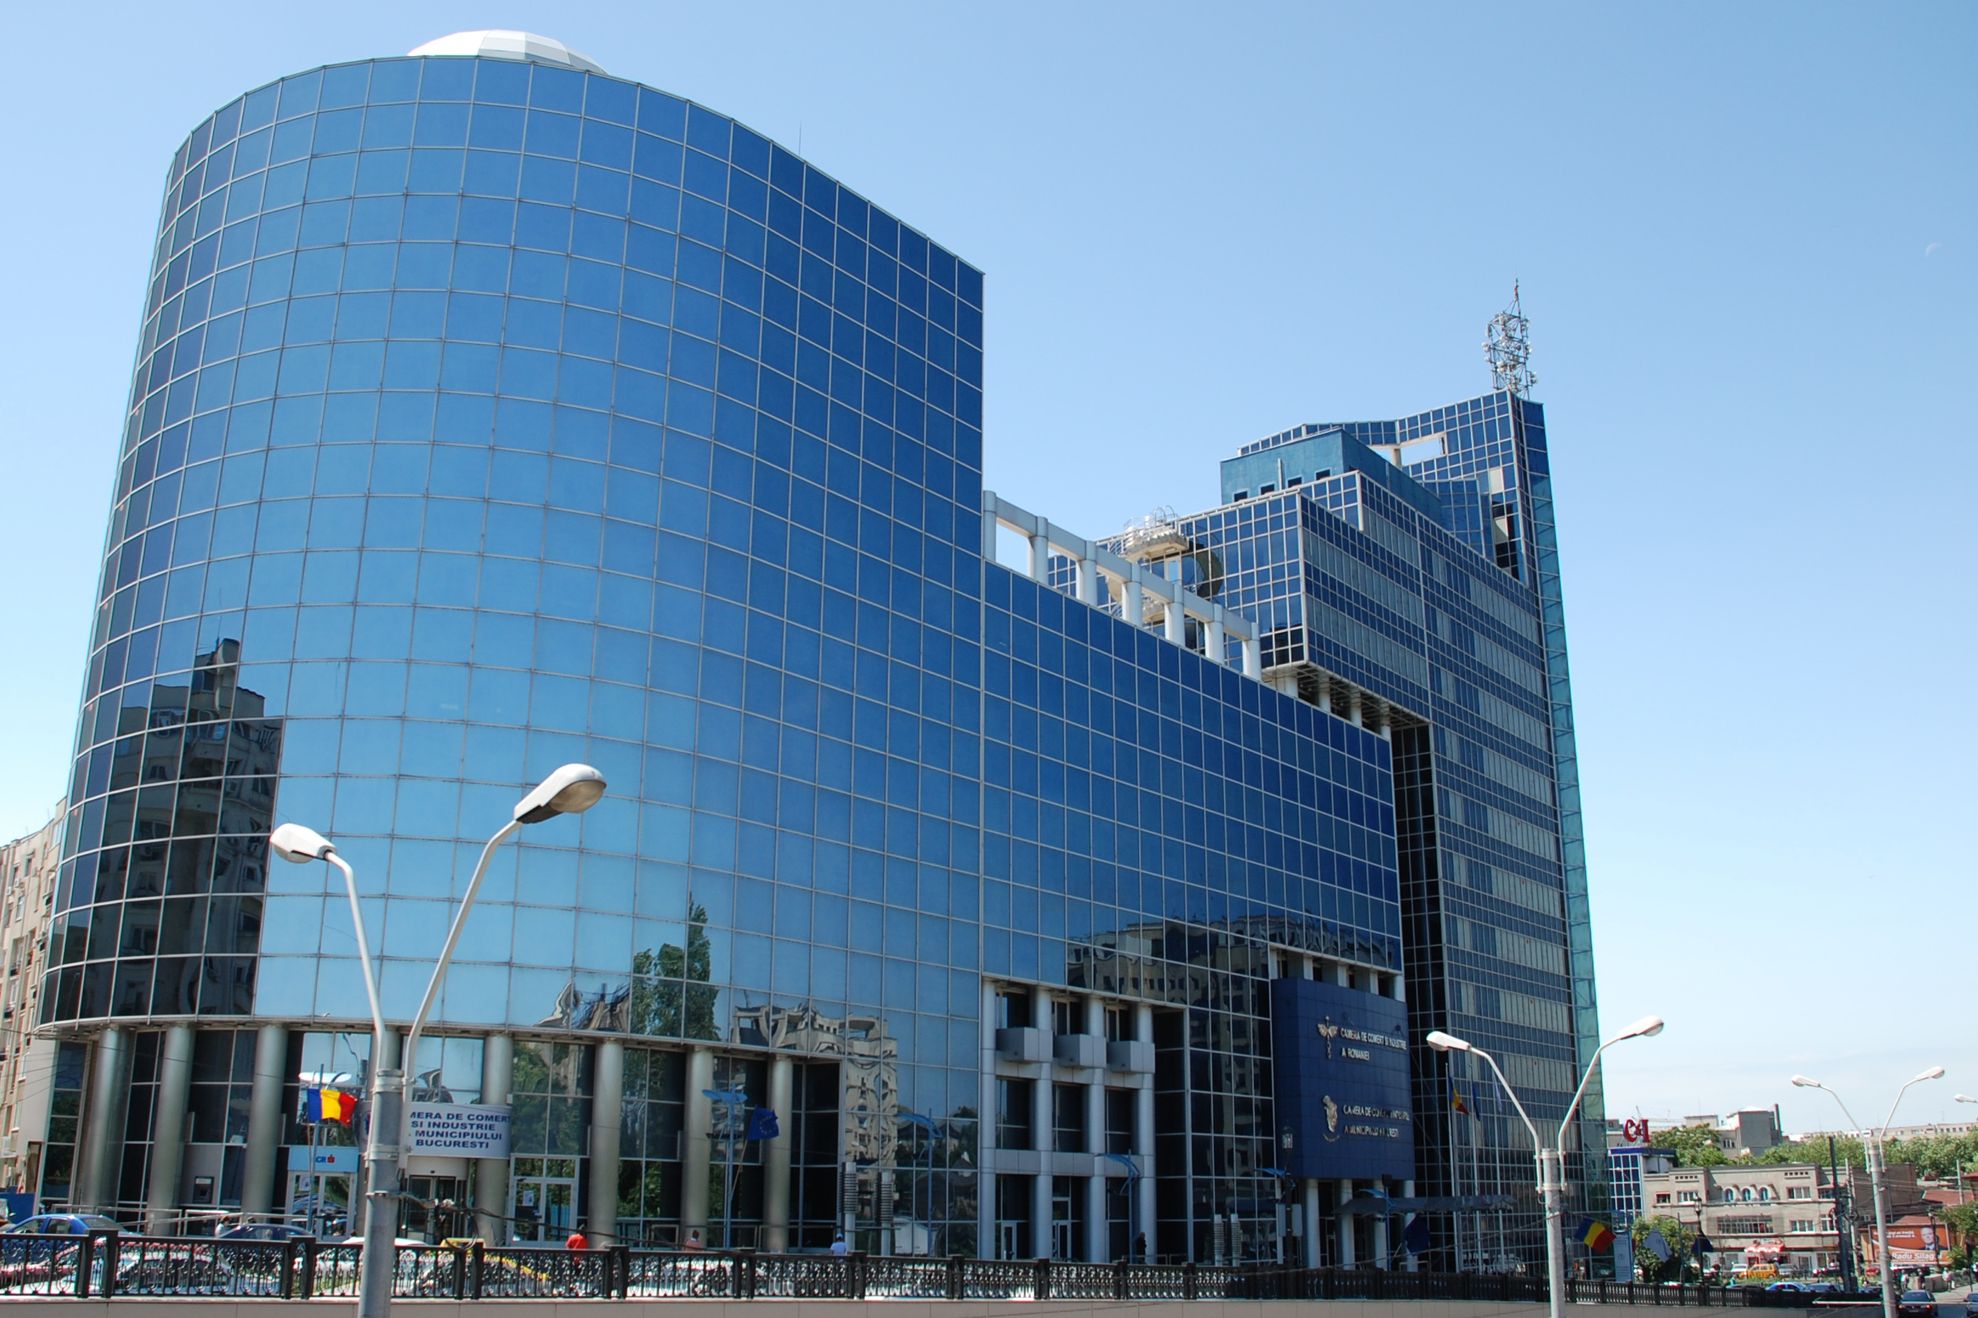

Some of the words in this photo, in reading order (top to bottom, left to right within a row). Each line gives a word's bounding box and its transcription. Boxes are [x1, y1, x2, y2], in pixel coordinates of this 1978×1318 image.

[446, 1112, 463, 1121] DE
[411, 1120, 424, 1128] SI
[427, 1121, 496, 1131] INDUSTRIE
[415, 1130, 502, 1140] MUNICIPIULUI
[415, 1139, 489, 1149] BUCURESTI
